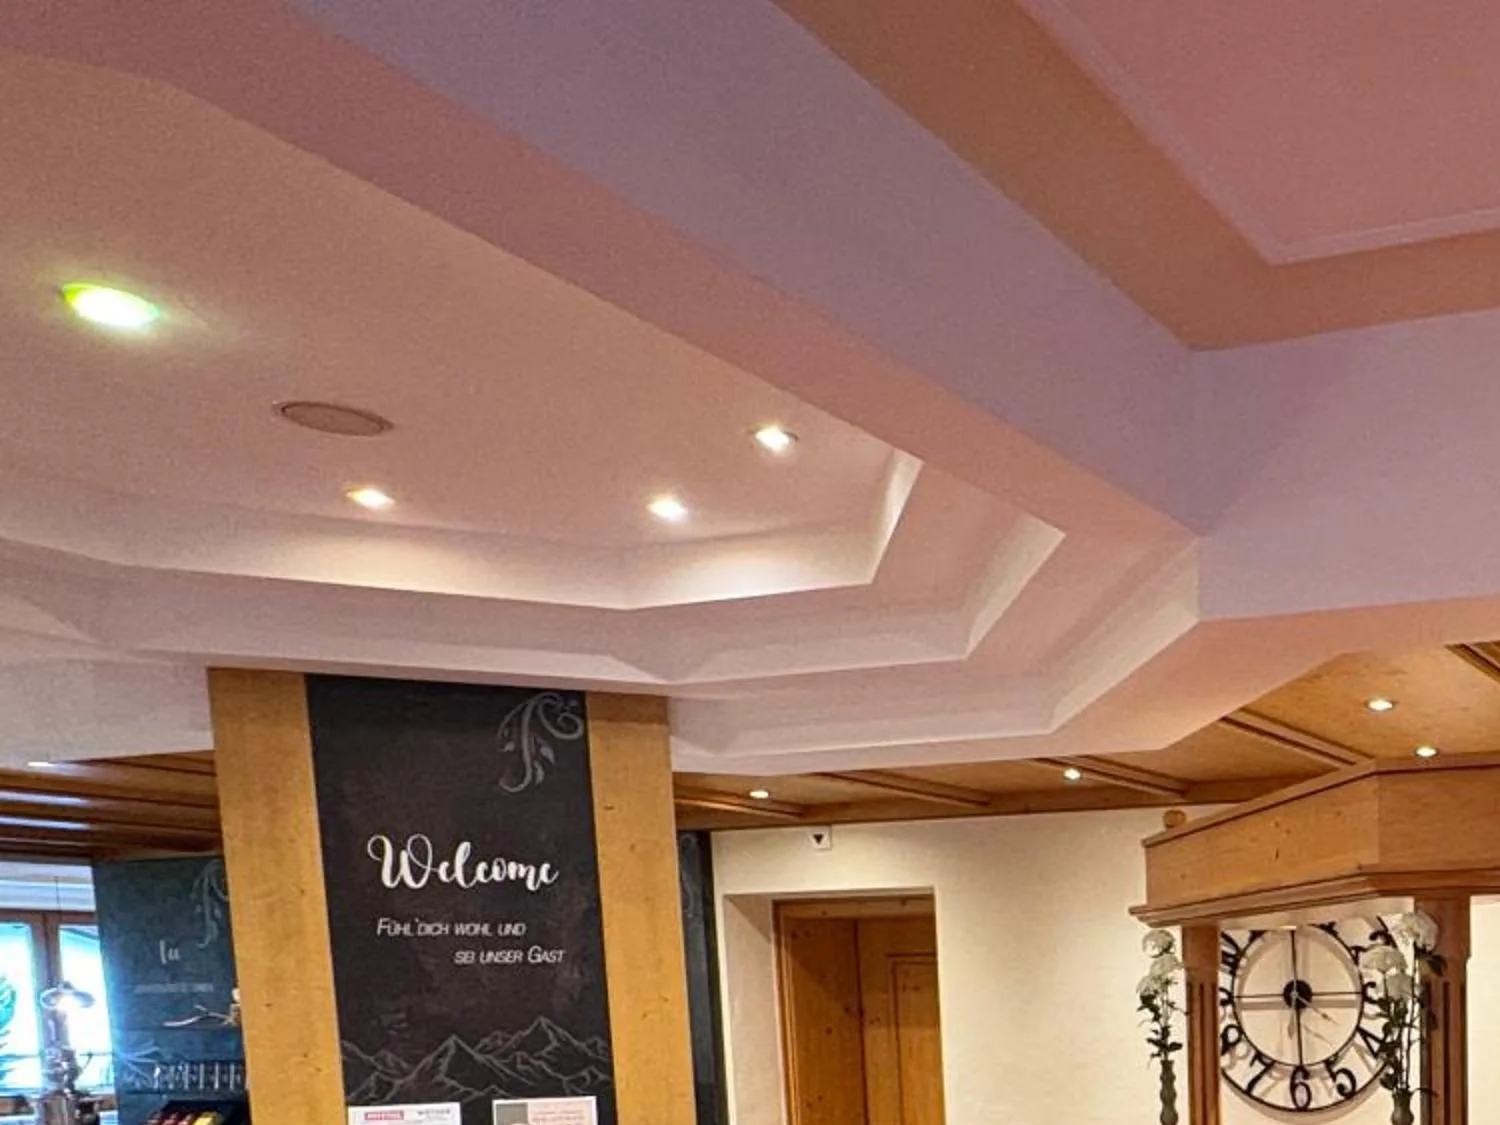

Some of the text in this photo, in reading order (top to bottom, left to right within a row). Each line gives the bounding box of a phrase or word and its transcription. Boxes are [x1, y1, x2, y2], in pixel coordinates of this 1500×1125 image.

[367, 833, 559, 891] Welcome
[454, 923, 493, 936] WOHL
[497, 923, 527, 936] UND
[454, 946, 566, 965] SEI UNSER GAST
[1247, 1051, 1275, 1095] 7
[1289, 1064, 1312, 1111] 6
[1324, 1053, 1357, 1099] 5
